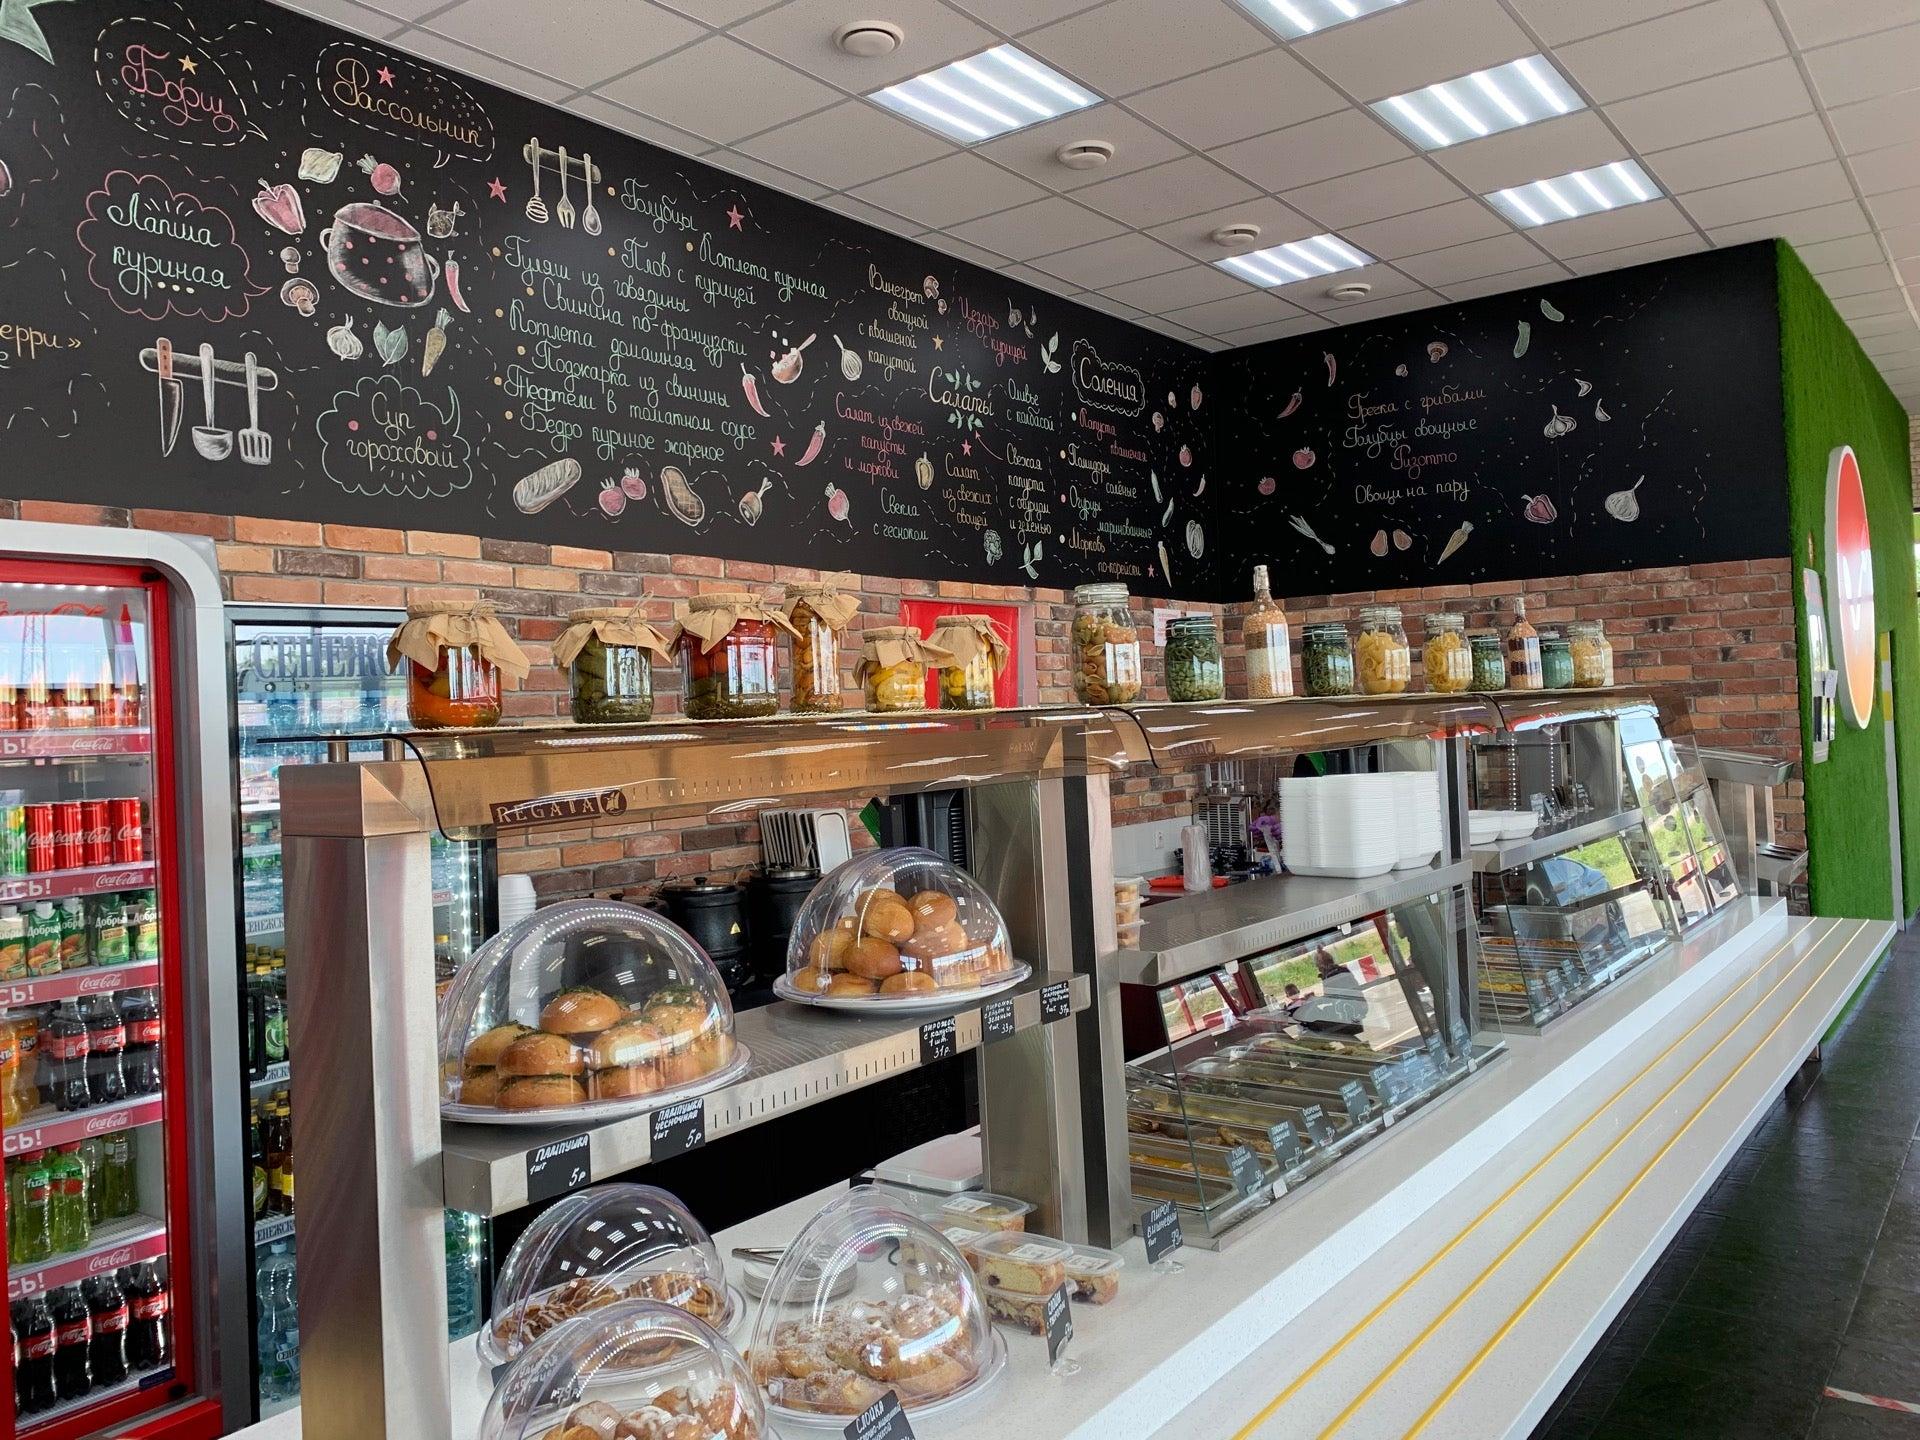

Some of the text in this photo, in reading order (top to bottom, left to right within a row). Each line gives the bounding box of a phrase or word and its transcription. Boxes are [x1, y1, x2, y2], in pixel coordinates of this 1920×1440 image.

[122, 43, 240, 132] Борщ
[333, 57, 484, 147] Рассольник
[107, 192, 222, 248] Лапша
[620, 178, 698, 233] Голубцы
[113, 242, 231, 299] куриная
[504, 235, 690, 320] Гуляш из говядины
[621, 237, 756, 308] Плов с курицей
[700, 232, 828, 302] Котлета куриная
[868, 263, 925, 309] Винегрет
[543, 277, 747, 368] Свинина по-французски
[888, 301, 929, 331] овощной
[959, 296, 999, 338] Цезарь
[509, 298, 697, 371] Котлета домашняя
[859, 319, 917, 349] с квашеной
[868, 350, 916, 382] капустой
[983, 335, 1027, 367] с курицей
[532, 340, 730, 408] Поджарка из свинины
[1080, 357, 1138, 403] Соления
[504, 364, 756, 450] Тефтели в томатном соусе
[929, 366, 995, 416] Салаты
[1008, 378, 1039, 406] Оливье
[1348, 384, 1487, 424] Гречка с грибами
[371, 392, 415, 439] Суп
[836, 391, 925, 440] Салат из свежей
[1007, 406, 1054, 431] с колбасой
[1080, 408, 1117, 441] Капуста
[520, 401, 724, 466] Бедро куриное жареное
[861, 435, 906, 463] капусты
[1343, 418, 1479, 458] Голубцы овощные
[346, 440, 459, 472] гороховый
[945, 452, 980, 480] Салат
[1007, 443, 1042, 470] Свежая
[1068, 443, 1111, 484] Помидоры
[1110, 440, 1147, 462] квашеная
[1390, 444, 1457, 479] Ризотто
[845, 456, 899, 485] и моркови
[881, 487, 920, 517] Свекла
[942, 483, 992, 512] из свежих
[1008, 475, 1045, 500] капуста
[1009, 496, 1014, 508] с
[1070, 485, 1102, 521] Огурцы
[1355, 480, 1471, 504] Овощи на пару
[874, 523, 929, 541] с чесноком
[957, 507, 988, 530] овощей
[1009, 520, 1051, 545] и зеленью
[1097, 518, 1153, 542] маринованные
[1069, 526, 1105, 559] Морковь
[1098, 561, 1141, 580] по-корейски
[253, 635, 406, 679] СЕНЕЖС
[496, 797, 595, 824] REGATA
[655, 1099, 703, 1121] ПАМПУШКА
[535, 1136, 588, 1163] ПАМПУШКА
